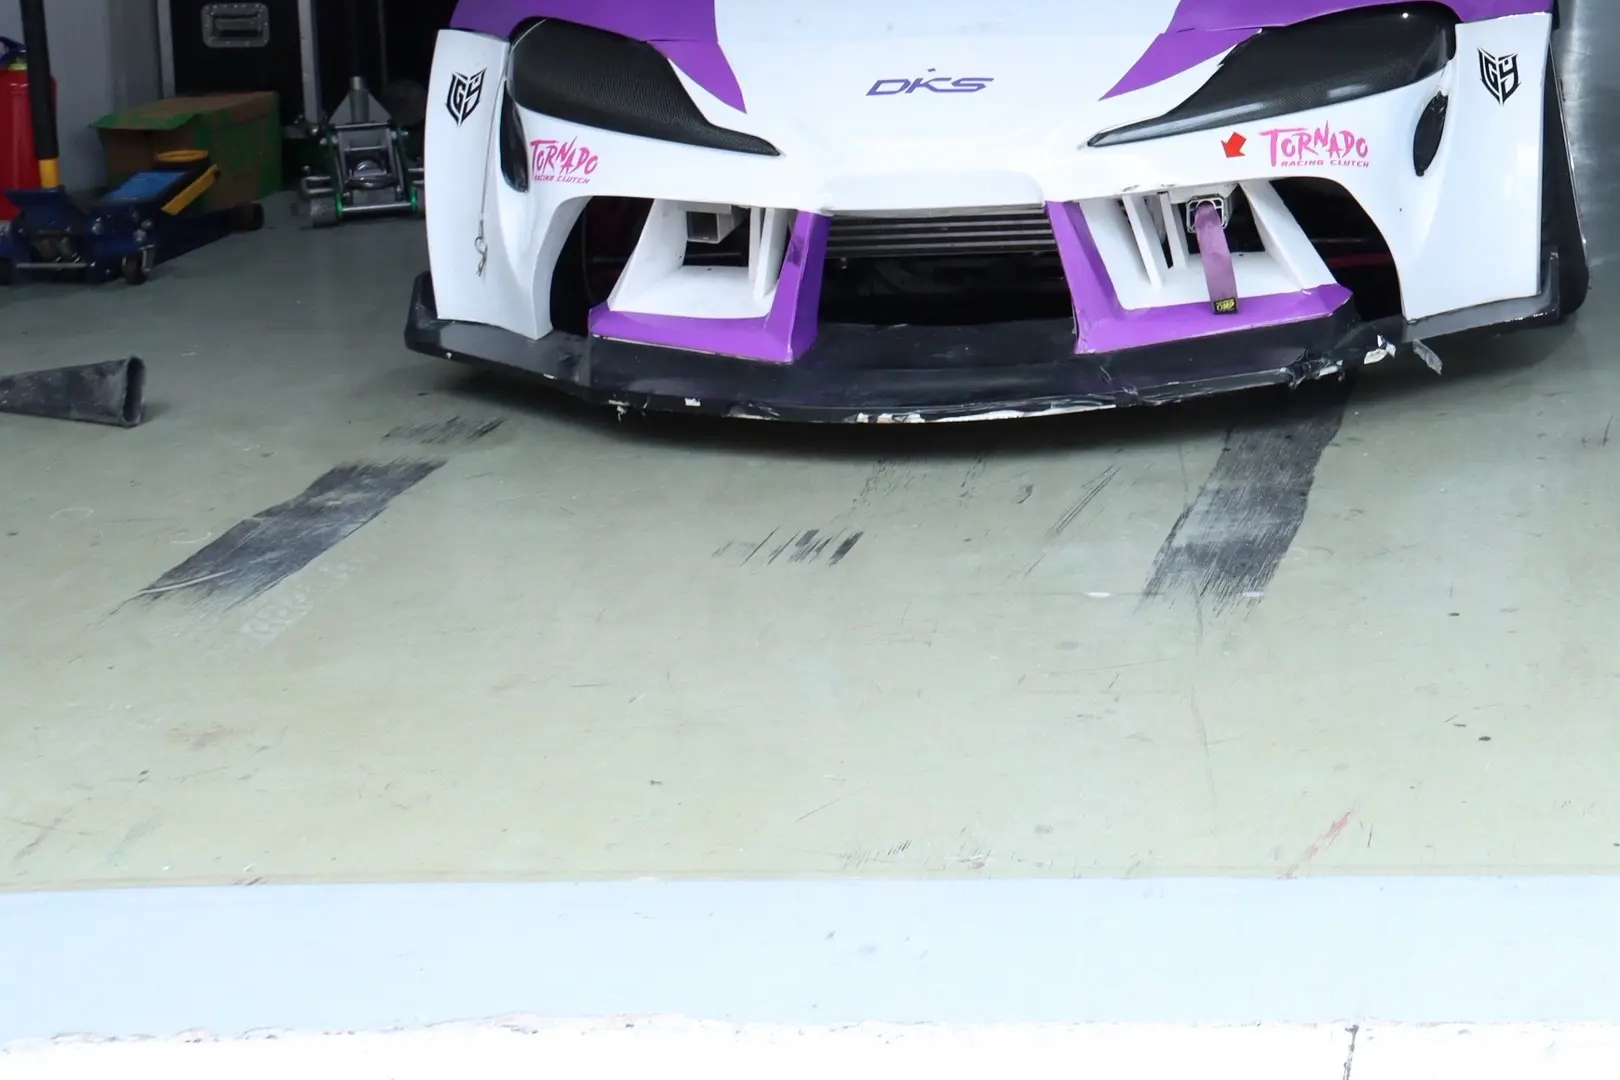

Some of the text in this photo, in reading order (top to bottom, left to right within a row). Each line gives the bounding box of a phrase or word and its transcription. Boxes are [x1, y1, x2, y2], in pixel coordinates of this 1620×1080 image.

[865, 76, 995, 96] DKS
[1259, 120, 1369, 167] TORNADO
[530, 136, 600, 177] TORNADO
[1281, 158, 1370, 168] RACING CLUTCH
[556, 175, 591, 184] CLUTCH
[1216, 299, 1236, 313] OMP
